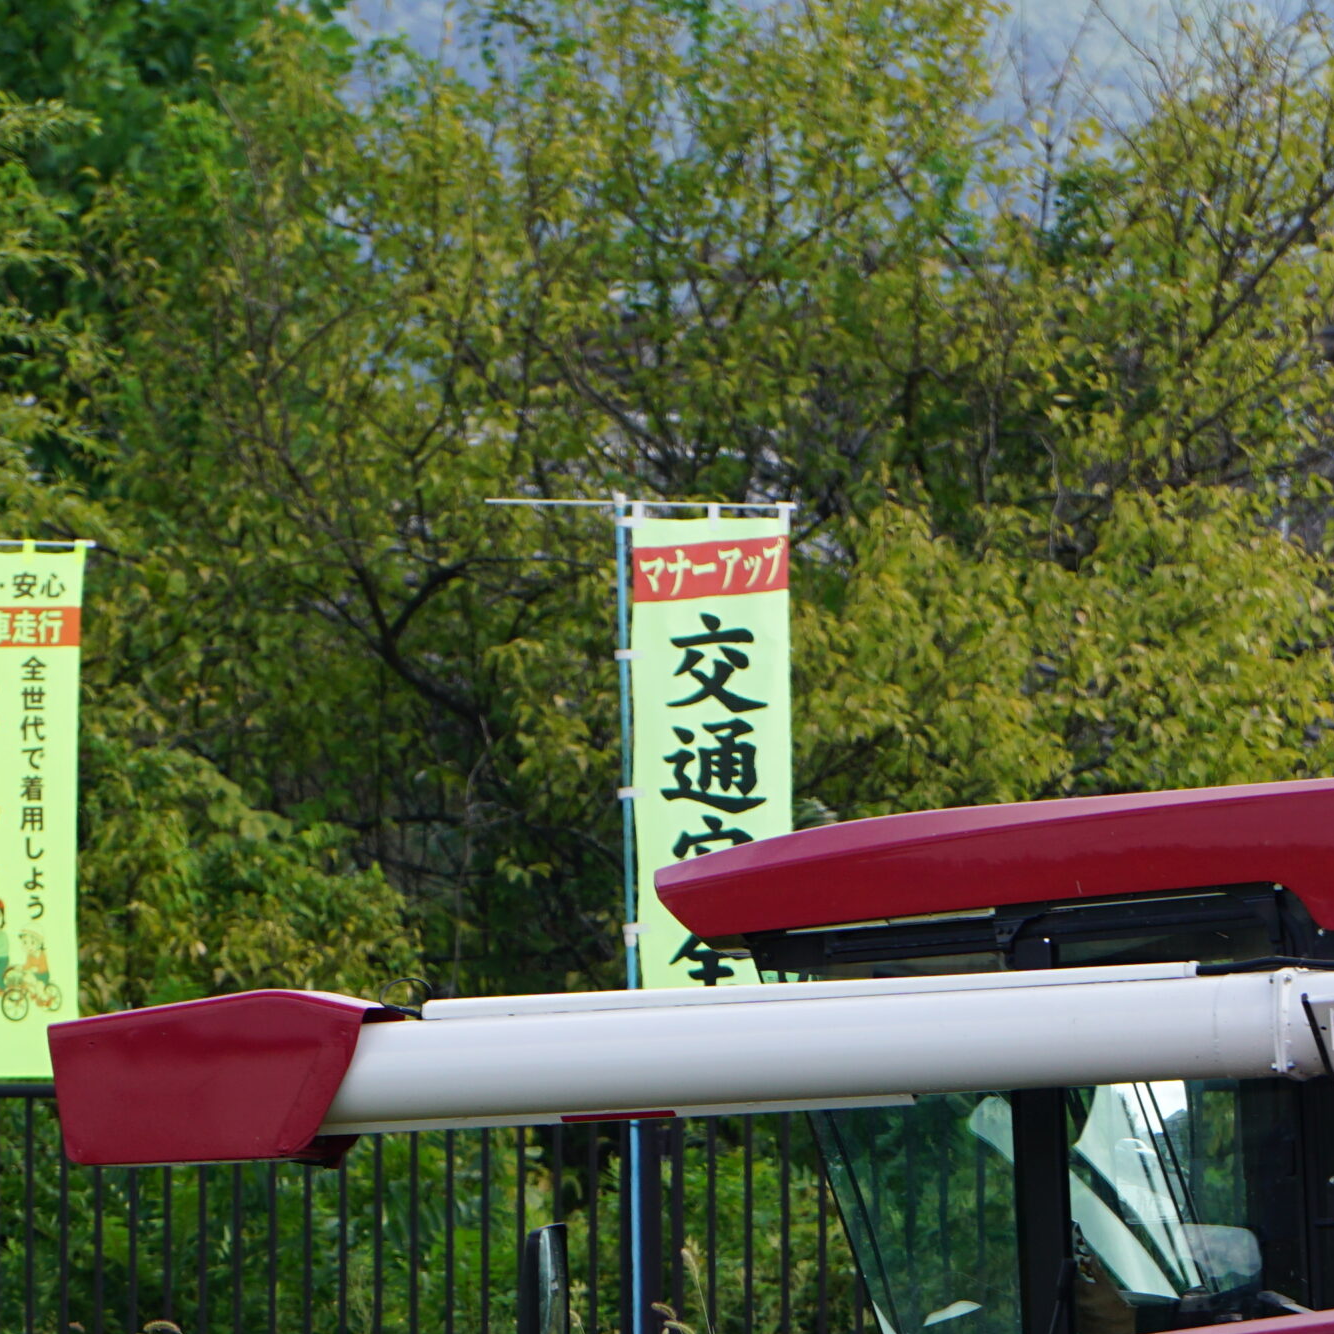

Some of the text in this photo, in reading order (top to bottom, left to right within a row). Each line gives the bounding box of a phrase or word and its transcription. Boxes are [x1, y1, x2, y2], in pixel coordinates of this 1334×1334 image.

[639, 536, 785, 597] マナーアップ
[20, 656, 47, 920] 全世代で着用しよう
